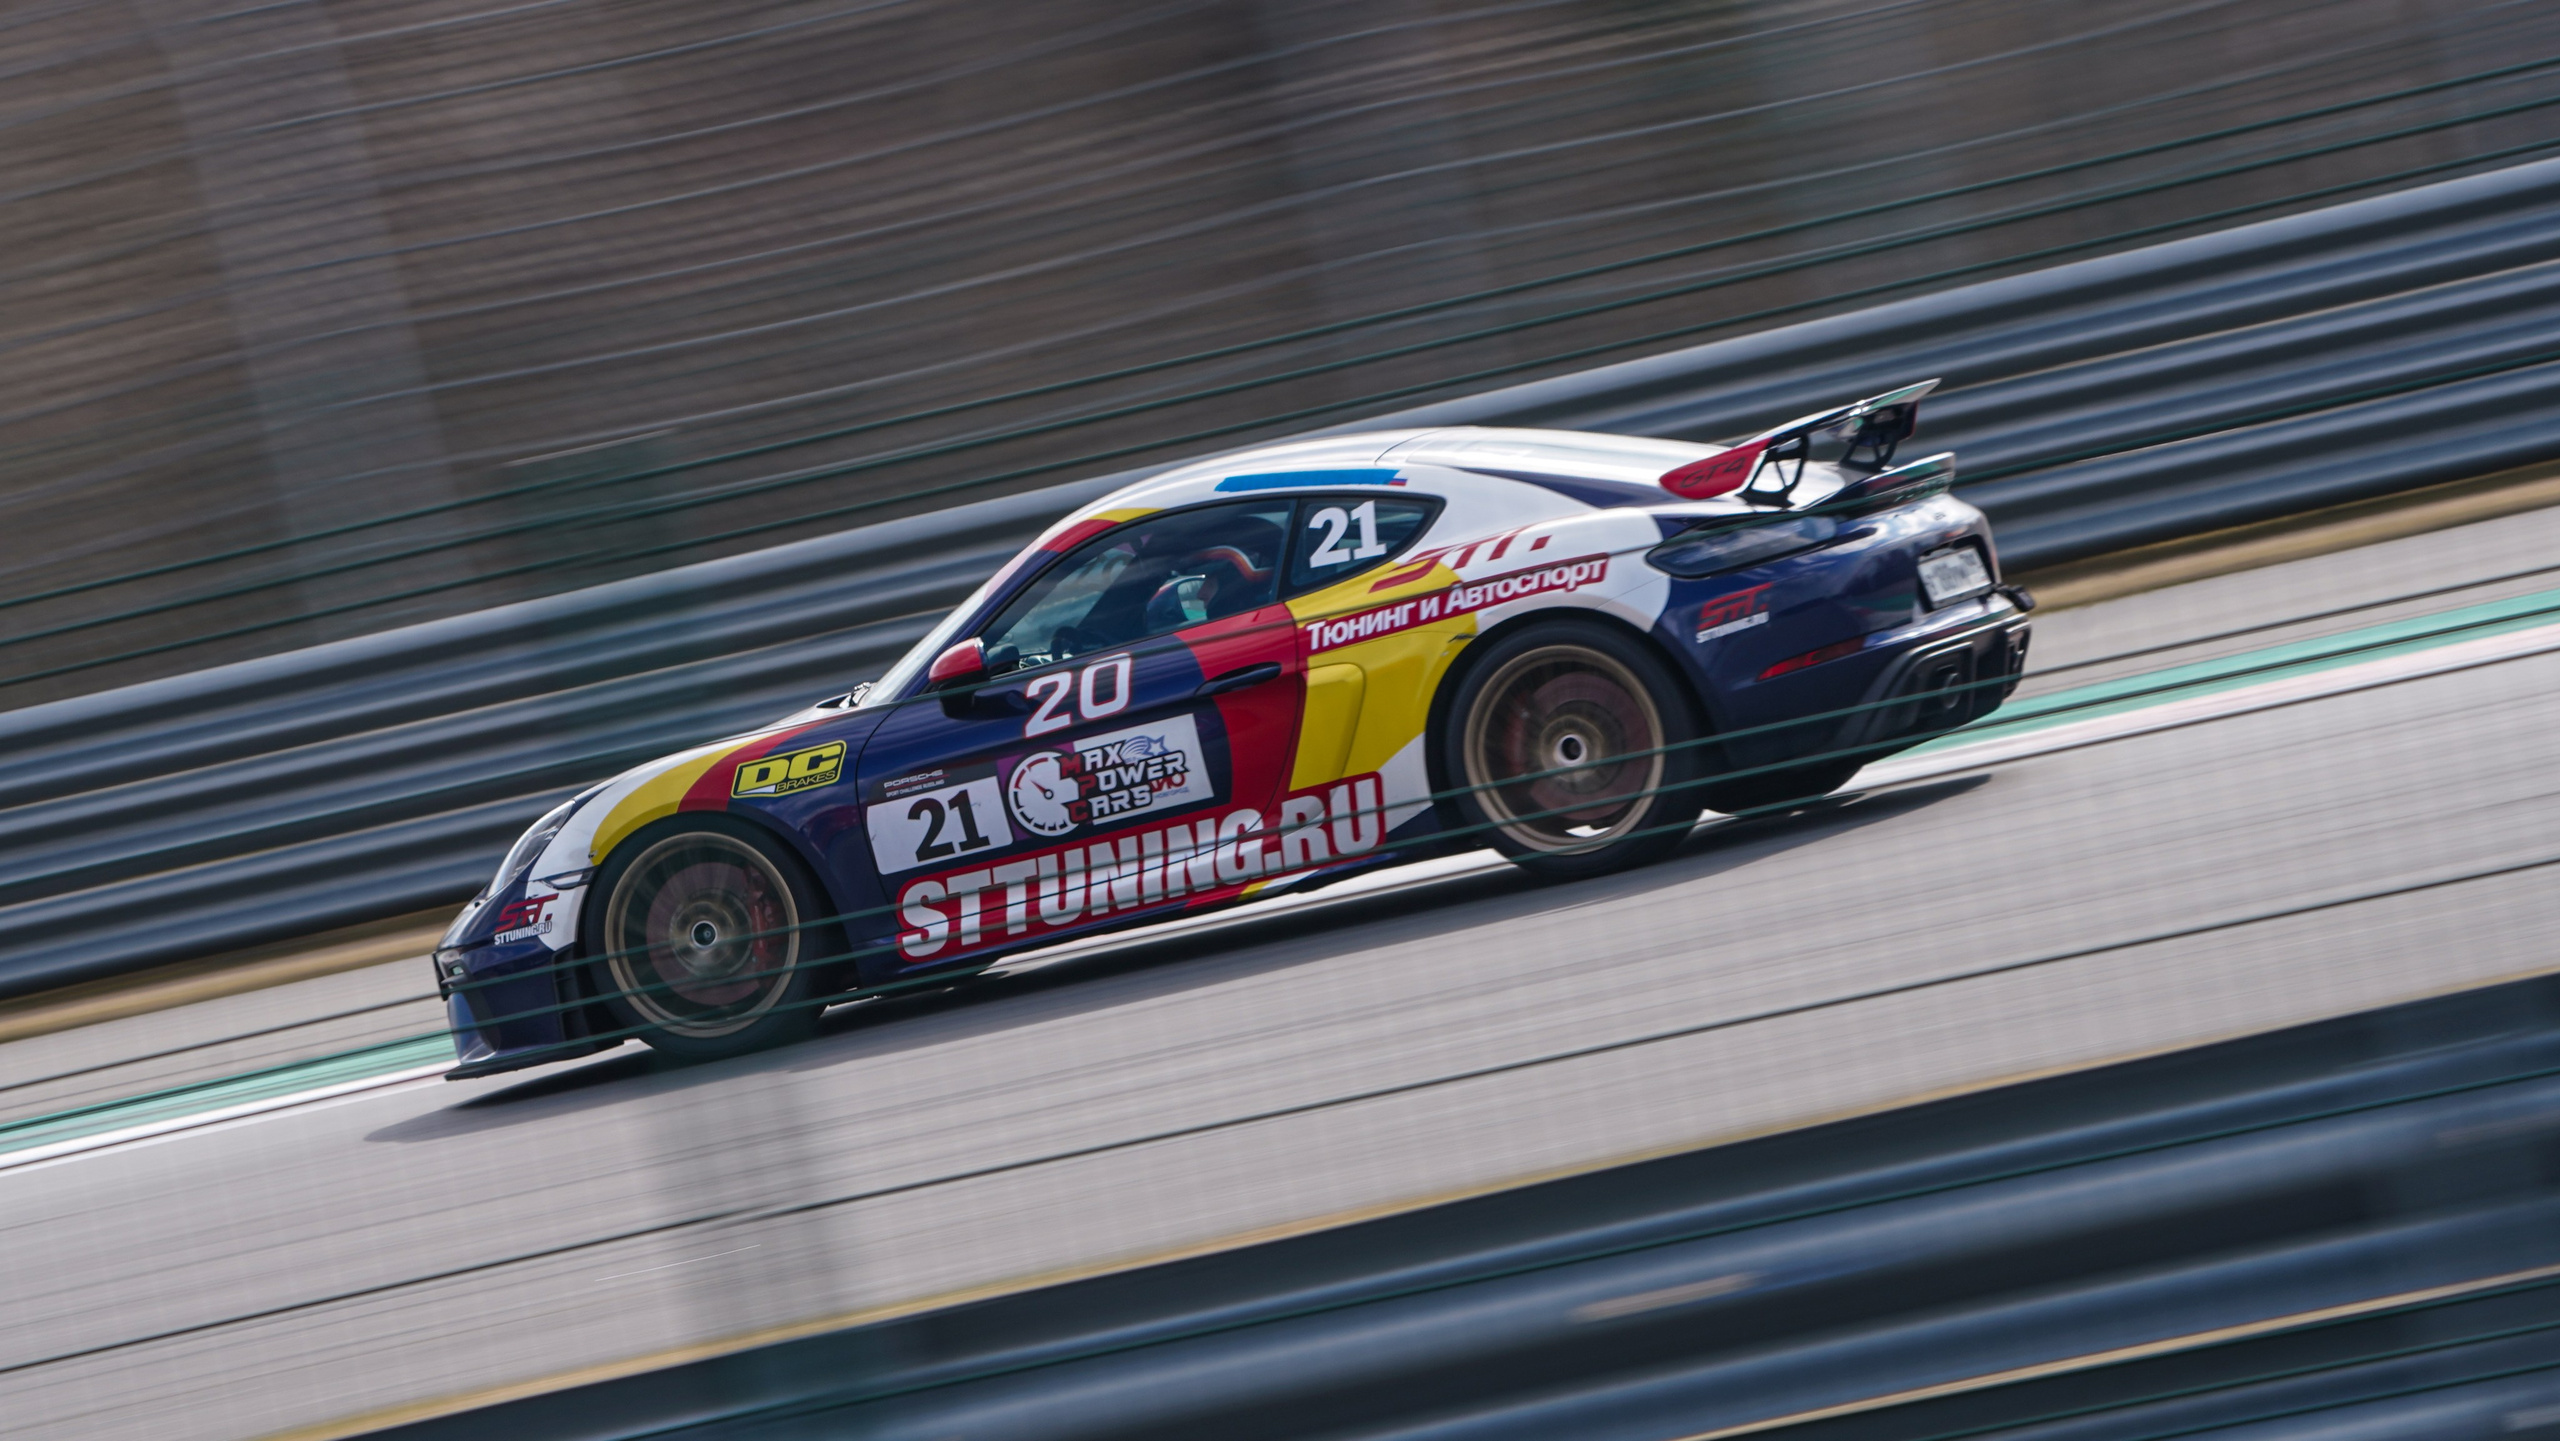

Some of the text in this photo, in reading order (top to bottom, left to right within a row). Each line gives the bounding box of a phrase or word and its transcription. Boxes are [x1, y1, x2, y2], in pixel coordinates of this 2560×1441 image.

[1681, 457, 1747, 488] GT4
[1308, 500, 1388, 569] 21
[1306, 602, 1418, 650] Тюнинг
[1444, 559, 1609, 614] Автоспорт
[1023, 653, 1133, 738] 20
[737, 744, 842, 792] DC
[776, 770, 836, 793] BRAKES
[883, 769, 944, 788] PORSCHE
[1059, 742, 1124, 777] MAX
[1078, 752, 1187, 796] POWER
[1068, 785, 1151, 822] CARS
[908, 789, 991, 863] 21
[901, 777, 1380, 958] STTUNING.RU
[494, 921, 553, 946] STTUNING.RU
